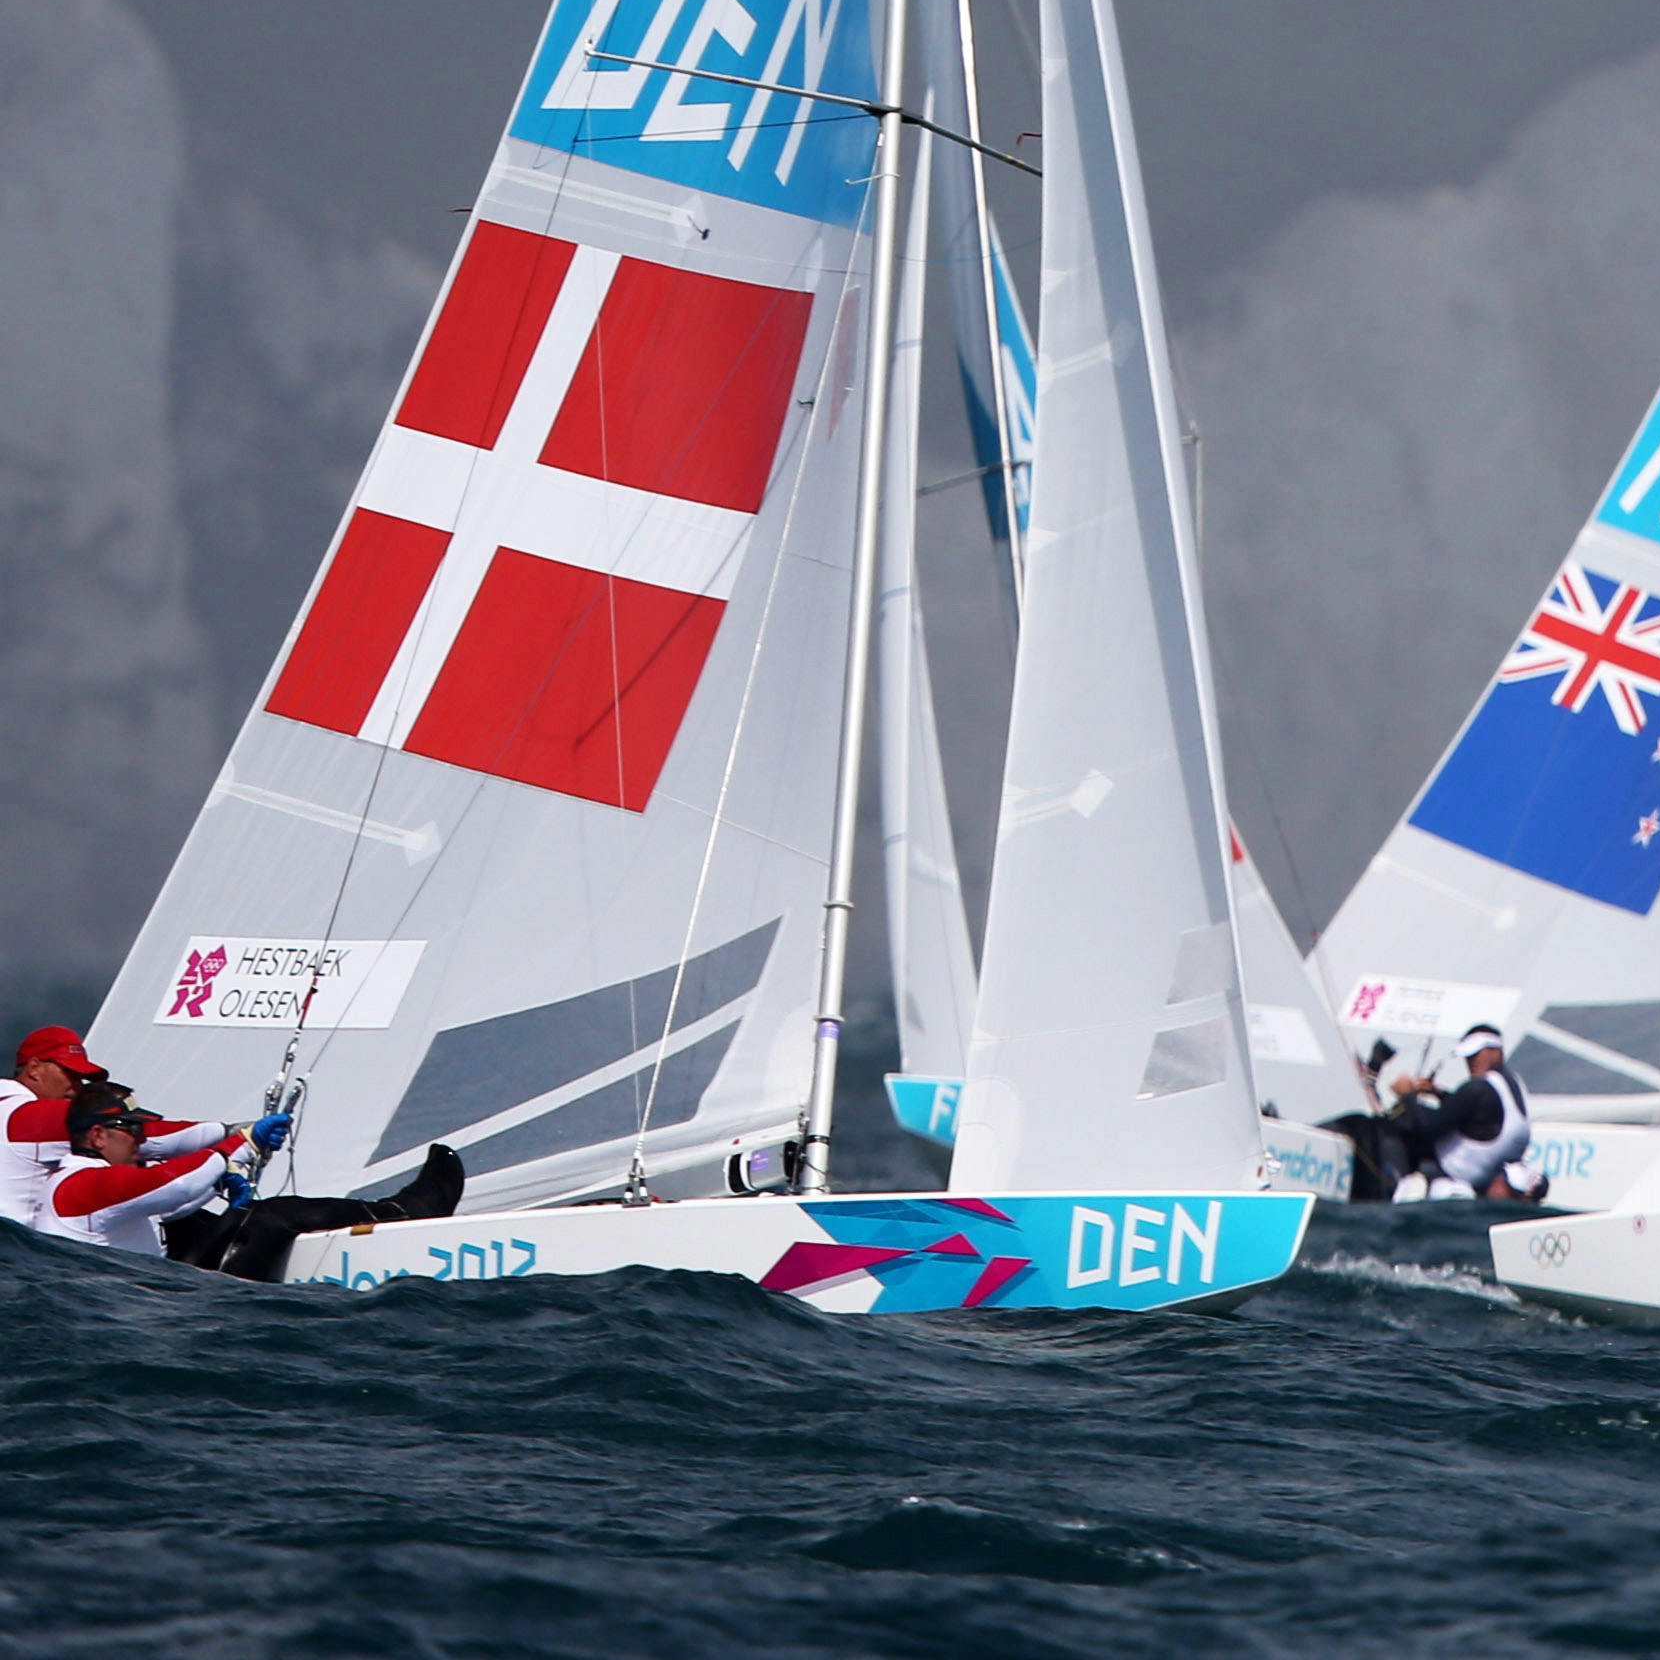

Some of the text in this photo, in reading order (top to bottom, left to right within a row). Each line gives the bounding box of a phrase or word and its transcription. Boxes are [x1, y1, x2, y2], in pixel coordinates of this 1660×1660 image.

[235, 947, 352, 977] HESTBAEK
[218, 989, 303, 1018] OLESEN
[1066, 1200, 1223, 1289] DEN
